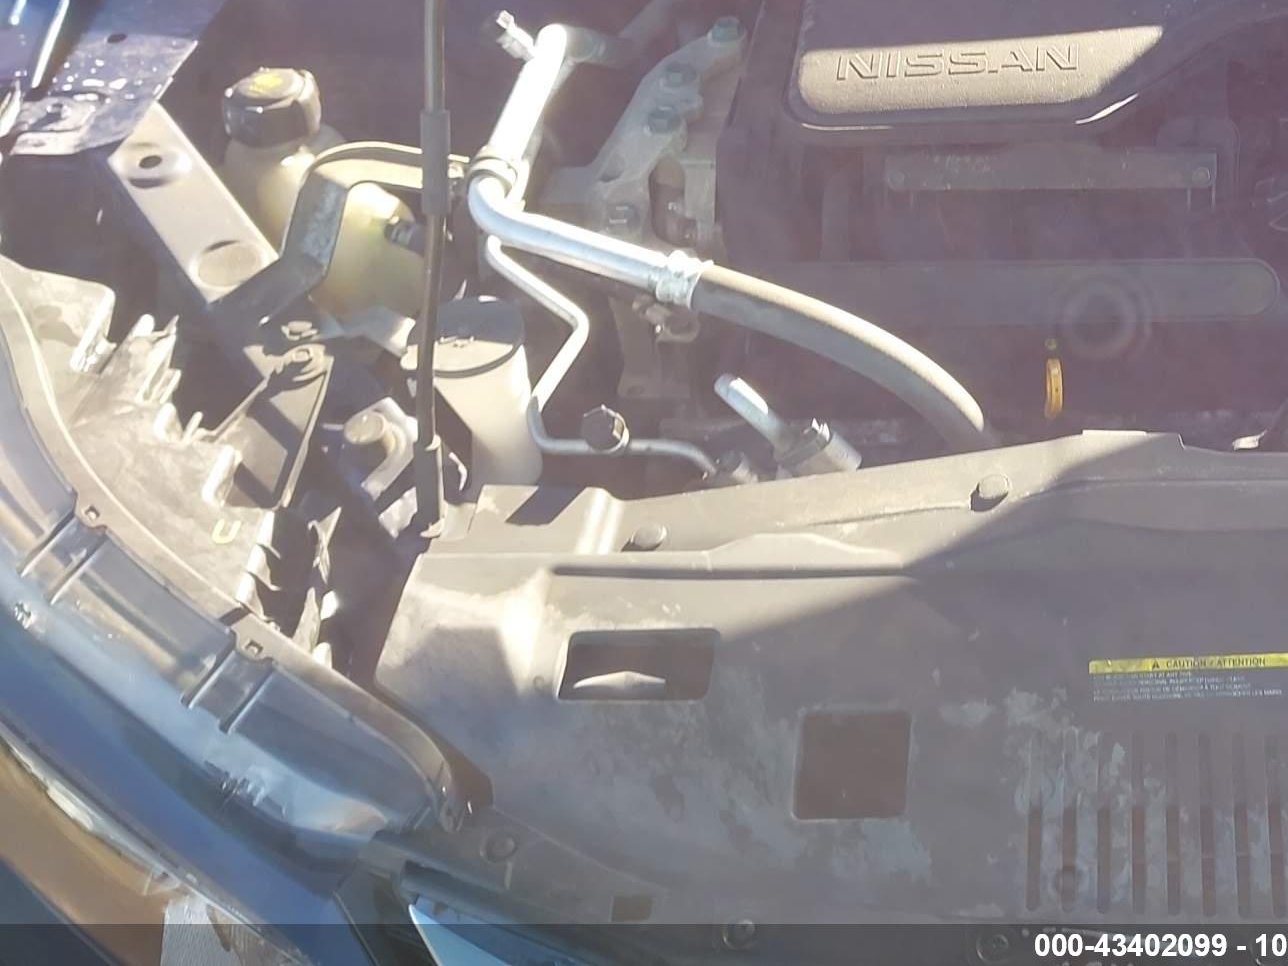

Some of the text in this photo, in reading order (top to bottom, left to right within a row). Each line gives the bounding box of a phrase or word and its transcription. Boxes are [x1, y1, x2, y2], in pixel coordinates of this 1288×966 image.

[836, 42, 1080, 81] NISSAN
[1166, 658, 1207, 669] CAUTION
[1216, 656, 1266, 667] ATTENTION
